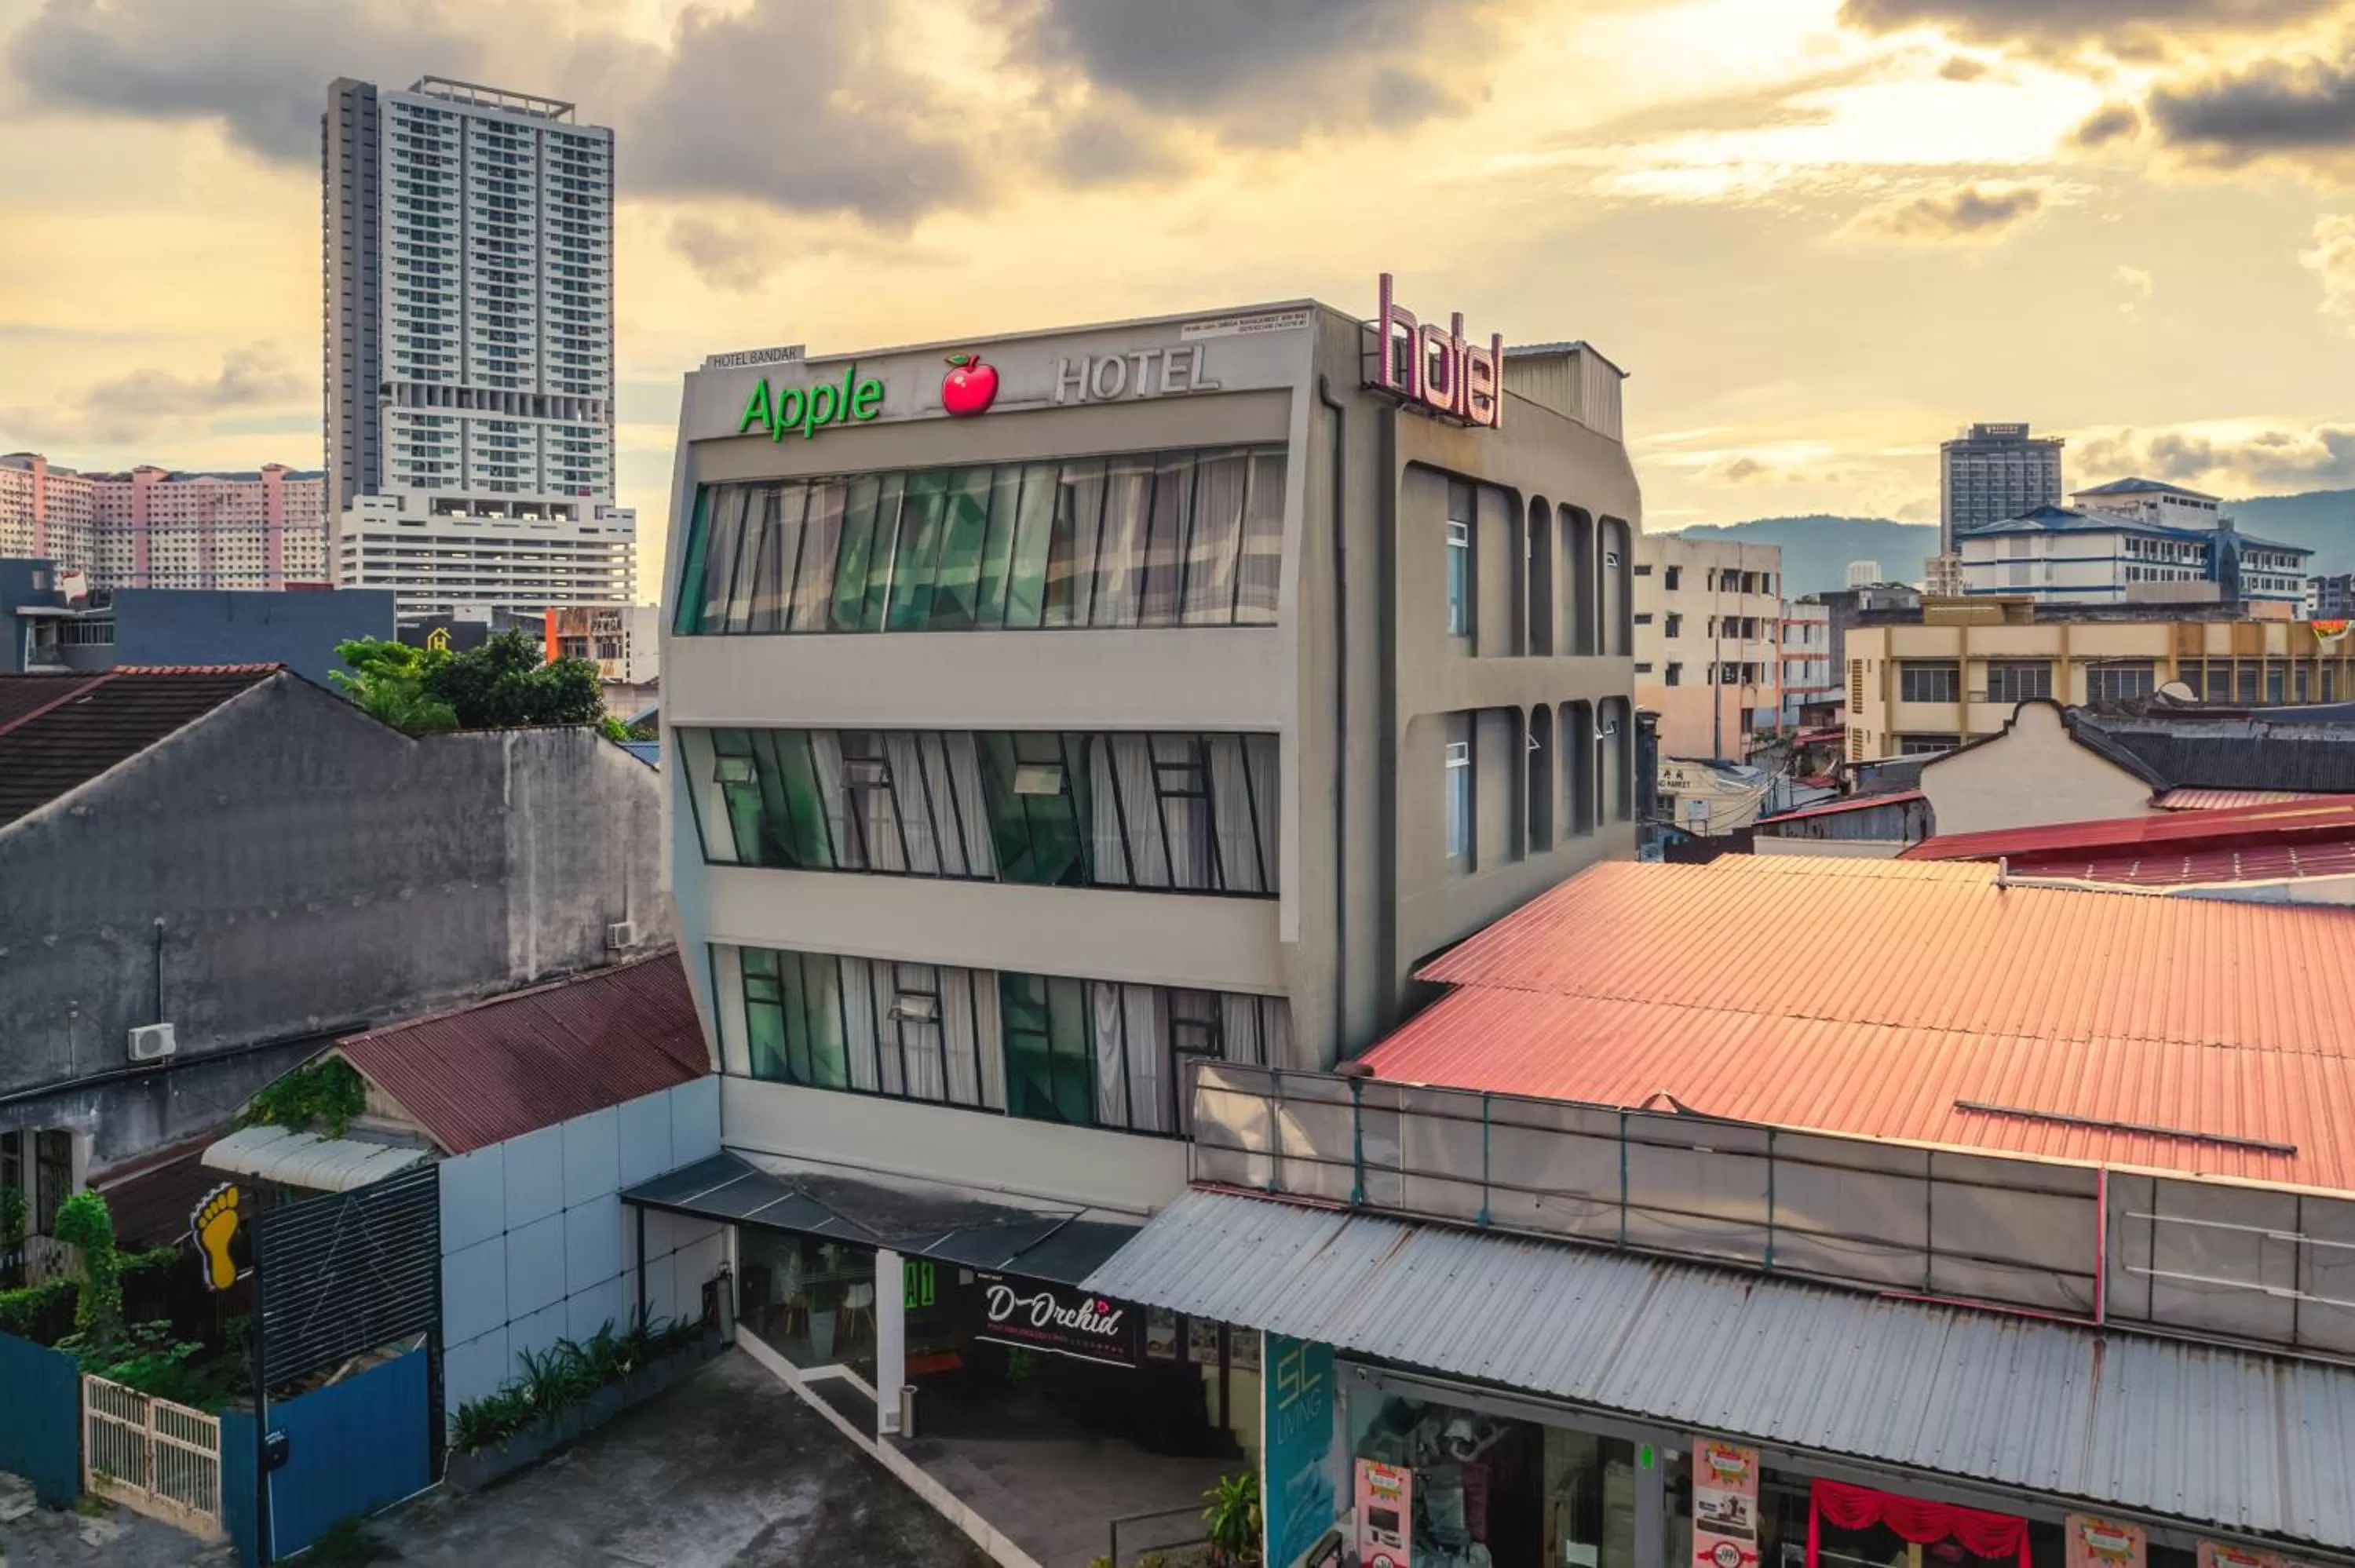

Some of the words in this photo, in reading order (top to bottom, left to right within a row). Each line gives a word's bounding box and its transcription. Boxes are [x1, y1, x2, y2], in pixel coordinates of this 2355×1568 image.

[714, 352, 747, 368] HOTEL
[750, 348, 796, 364] BANDAR
[1379, 273, 1502, 428] hotel
[739, 364, 883, 442] Apple
[1055, 345, 1219, 403] HOTEL
[987, 1285, 1123, 1336] D-Orchid
[1278, 1388, 1322, 1445] LIVING
